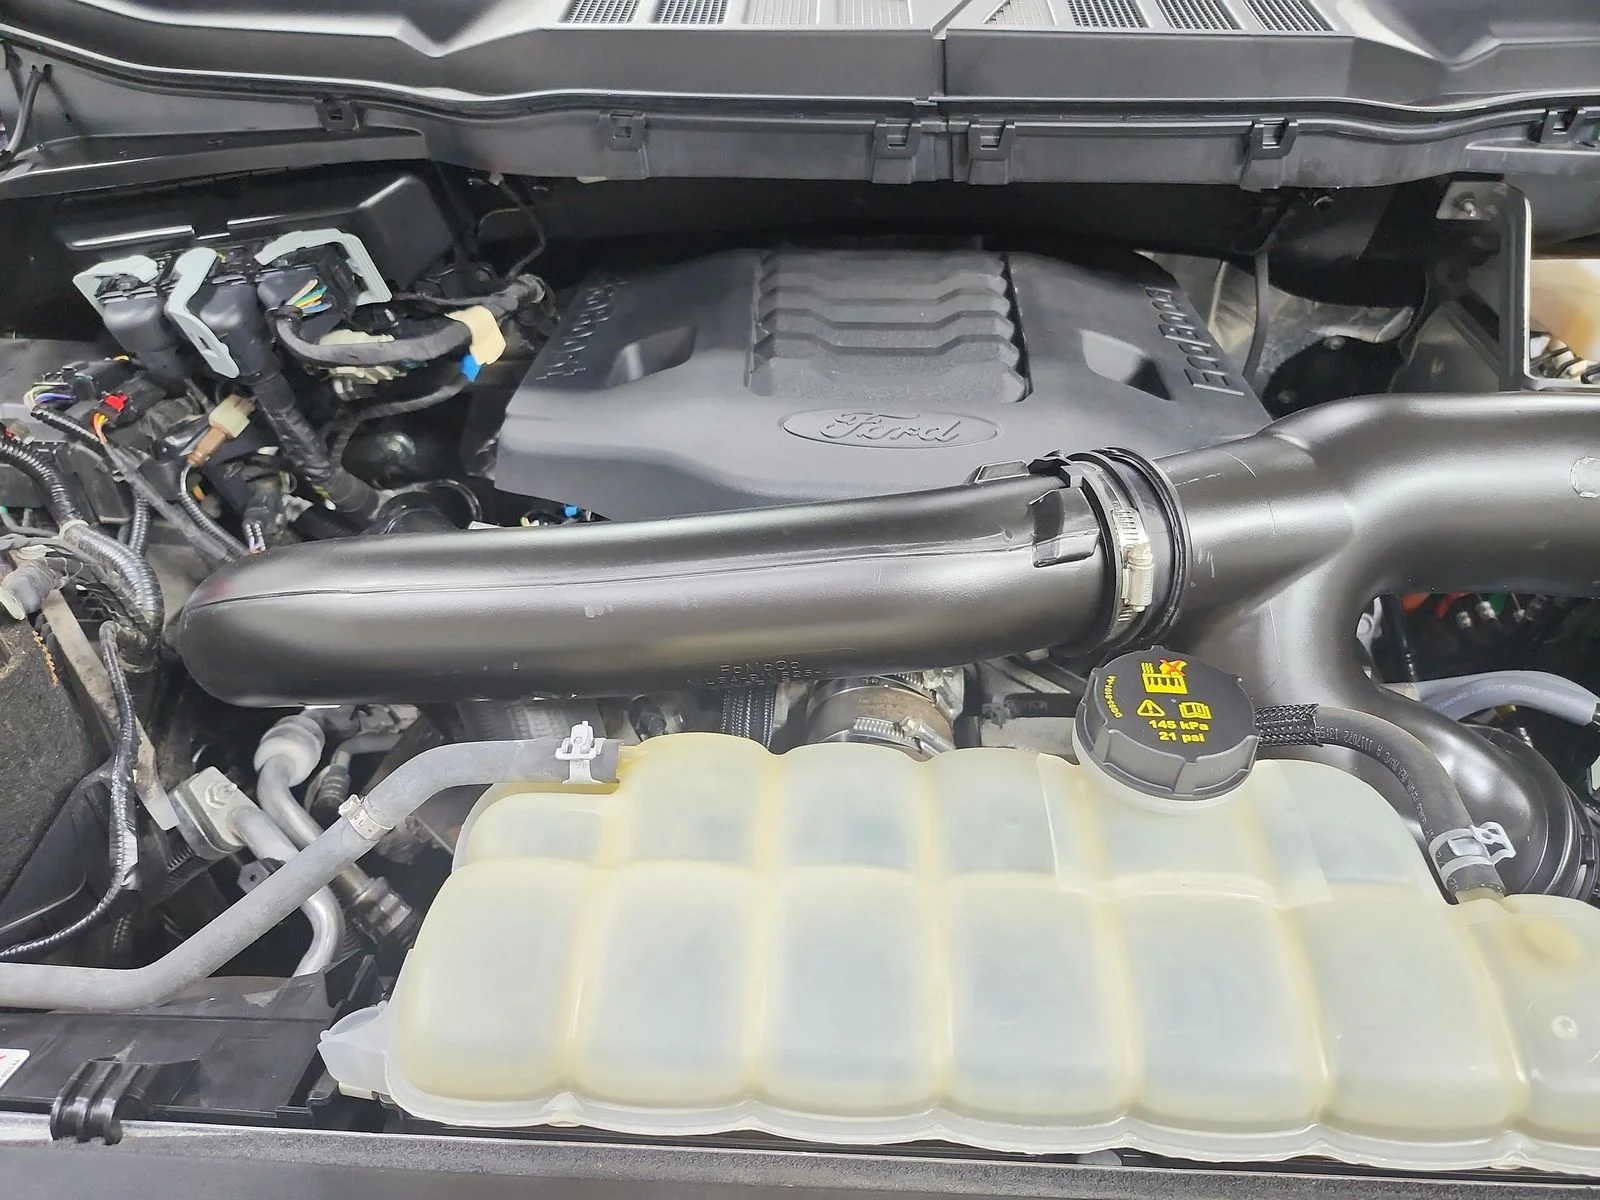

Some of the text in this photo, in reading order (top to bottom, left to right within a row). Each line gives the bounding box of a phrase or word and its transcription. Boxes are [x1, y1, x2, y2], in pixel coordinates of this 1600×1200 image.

[819, 411, 962, 443] Ford
[1148, 719, 1210, 732] 145 kPa
[1158, 731, 1205, 744] 21 psi
